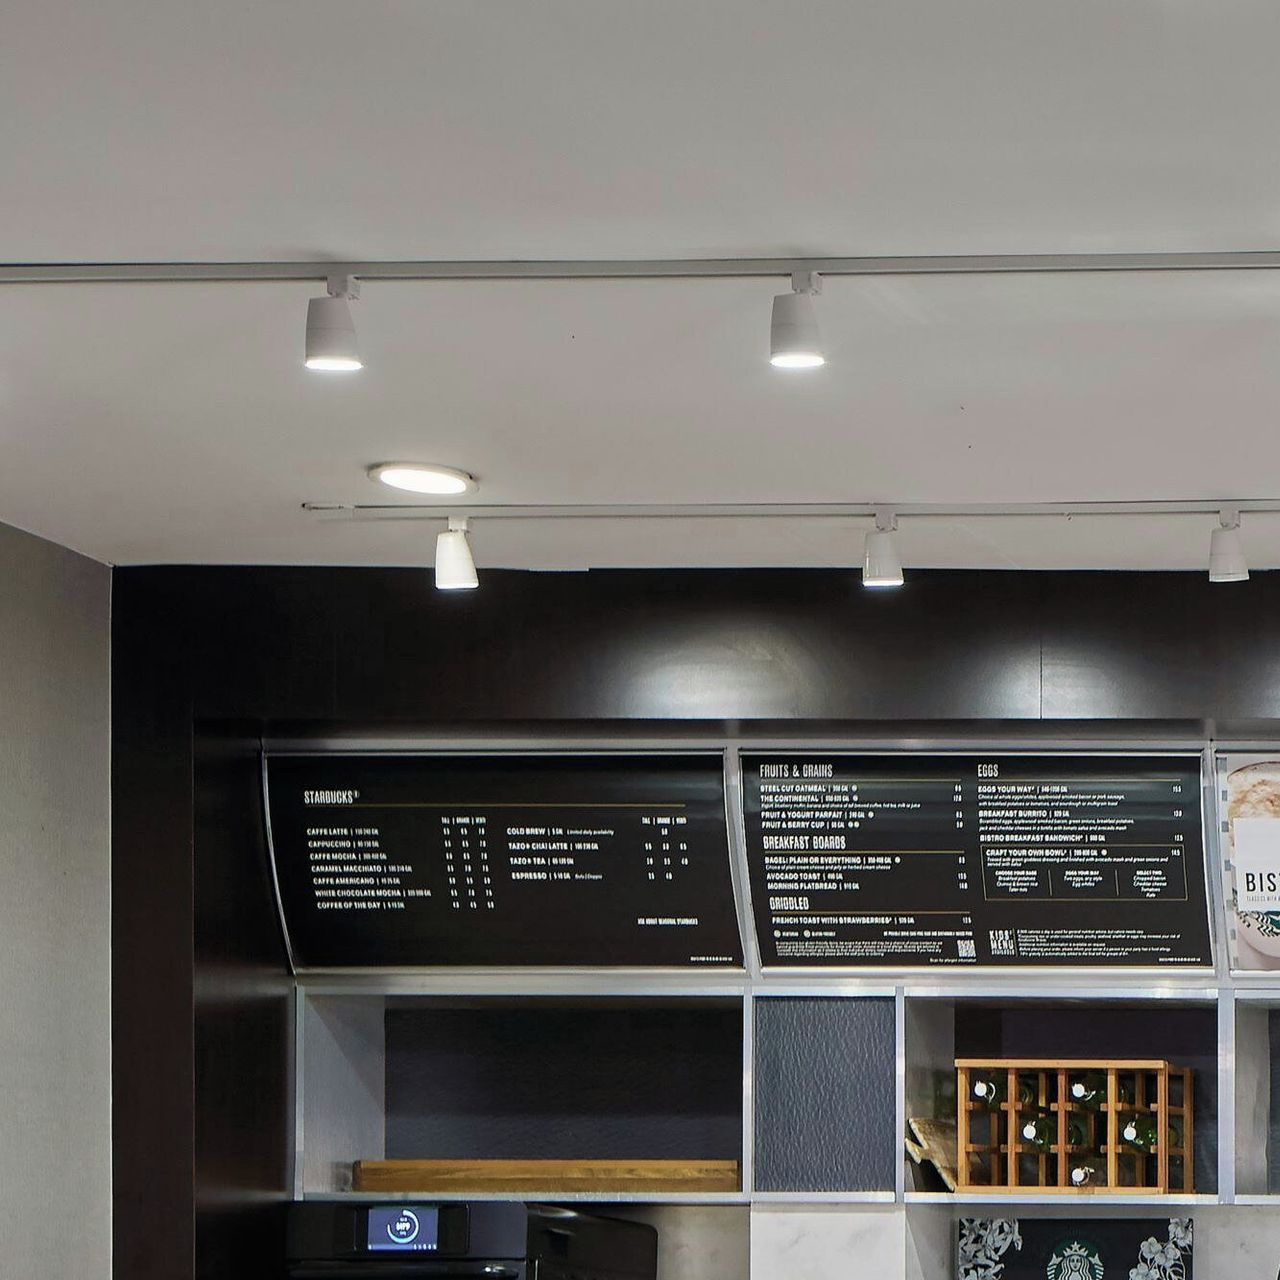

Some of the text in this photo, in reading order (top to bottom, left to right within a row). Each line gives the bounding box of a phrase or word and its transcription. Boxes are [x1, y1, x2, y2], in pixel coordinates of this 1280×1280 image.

[760, 764, 833, 778] FRUITS & GRAINS
[977, 764, 998, 777] EGGS
[786, 811, 814, 819] YOGURT
[815, 811, 843, 819] PARFAIT
[810, 821, 824, 829] CUP
[763, 836, 846, 849] BREAKFAST BOARDS
[1007, 849, 1026, 857] YOUR
[1027, 849, 1044, 857] OWN
[511, 872, 547, 880] ESPRESSO
[770, 897, 809, 910] GRIDDLED
[990, 940, 1014, 950] MENU
